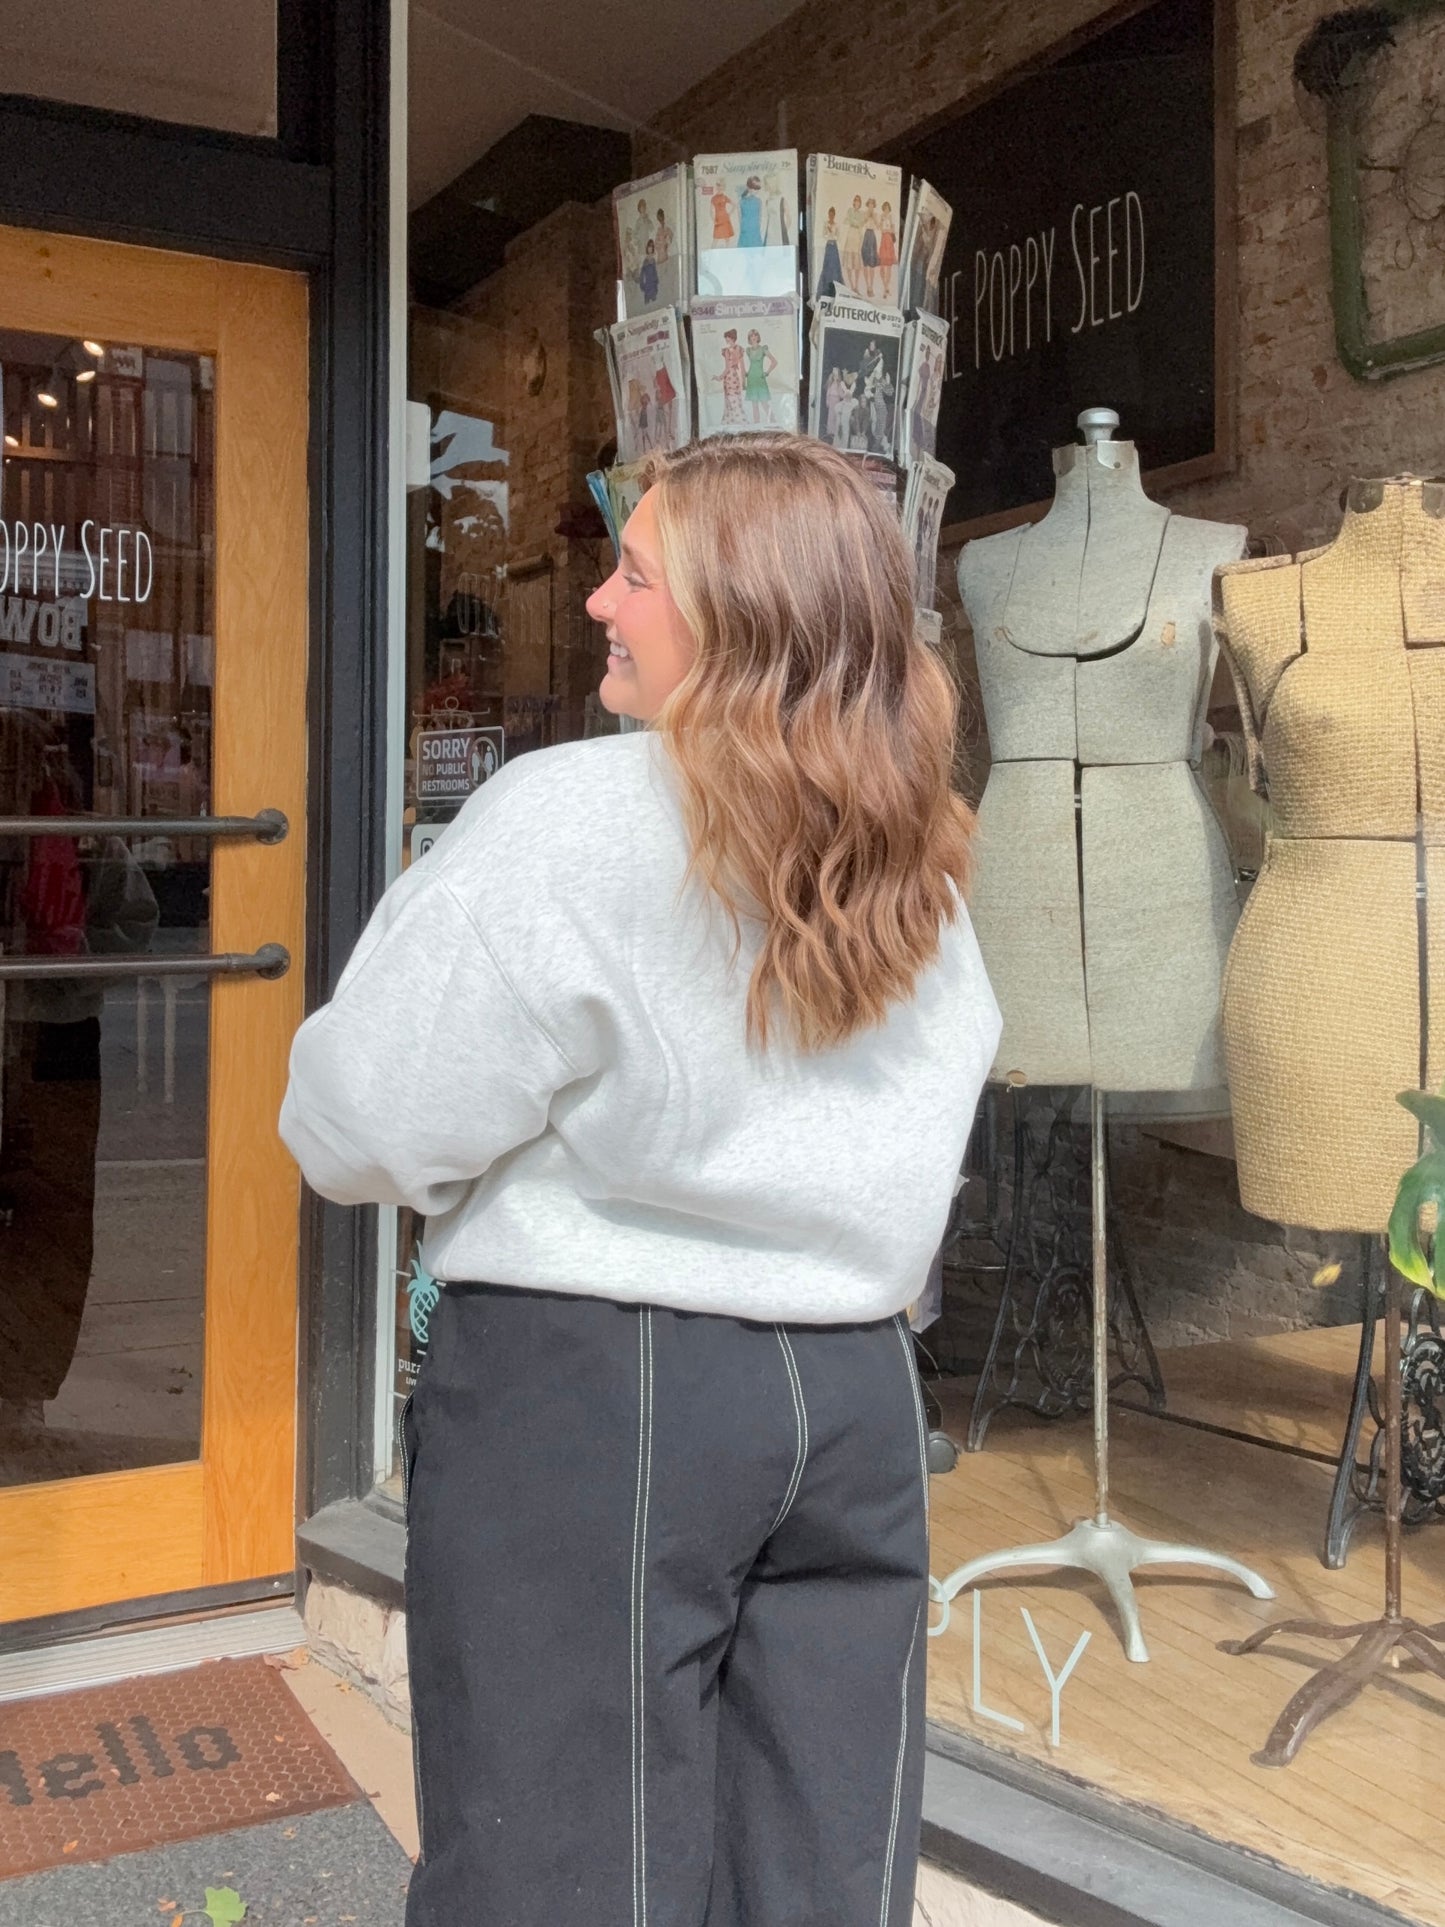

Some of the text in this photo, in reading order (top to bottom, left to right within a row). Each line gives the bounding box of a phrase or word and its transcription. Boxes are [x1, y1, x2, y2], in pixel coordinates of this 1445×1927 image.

[824, 154, 876, 180] Butterick
[974, 227, 1055, 370] POPPY
[1071, 191, 1145, 333] SEED
[715, 302, 772, 316] Simplicity
[80, 519, 153, 602] SEED
[422, 737, 471, 761] SORRY
[422, 762, 467, 776] NO PUBLIC
[422, 779, 470, 792] RESTROOMS
